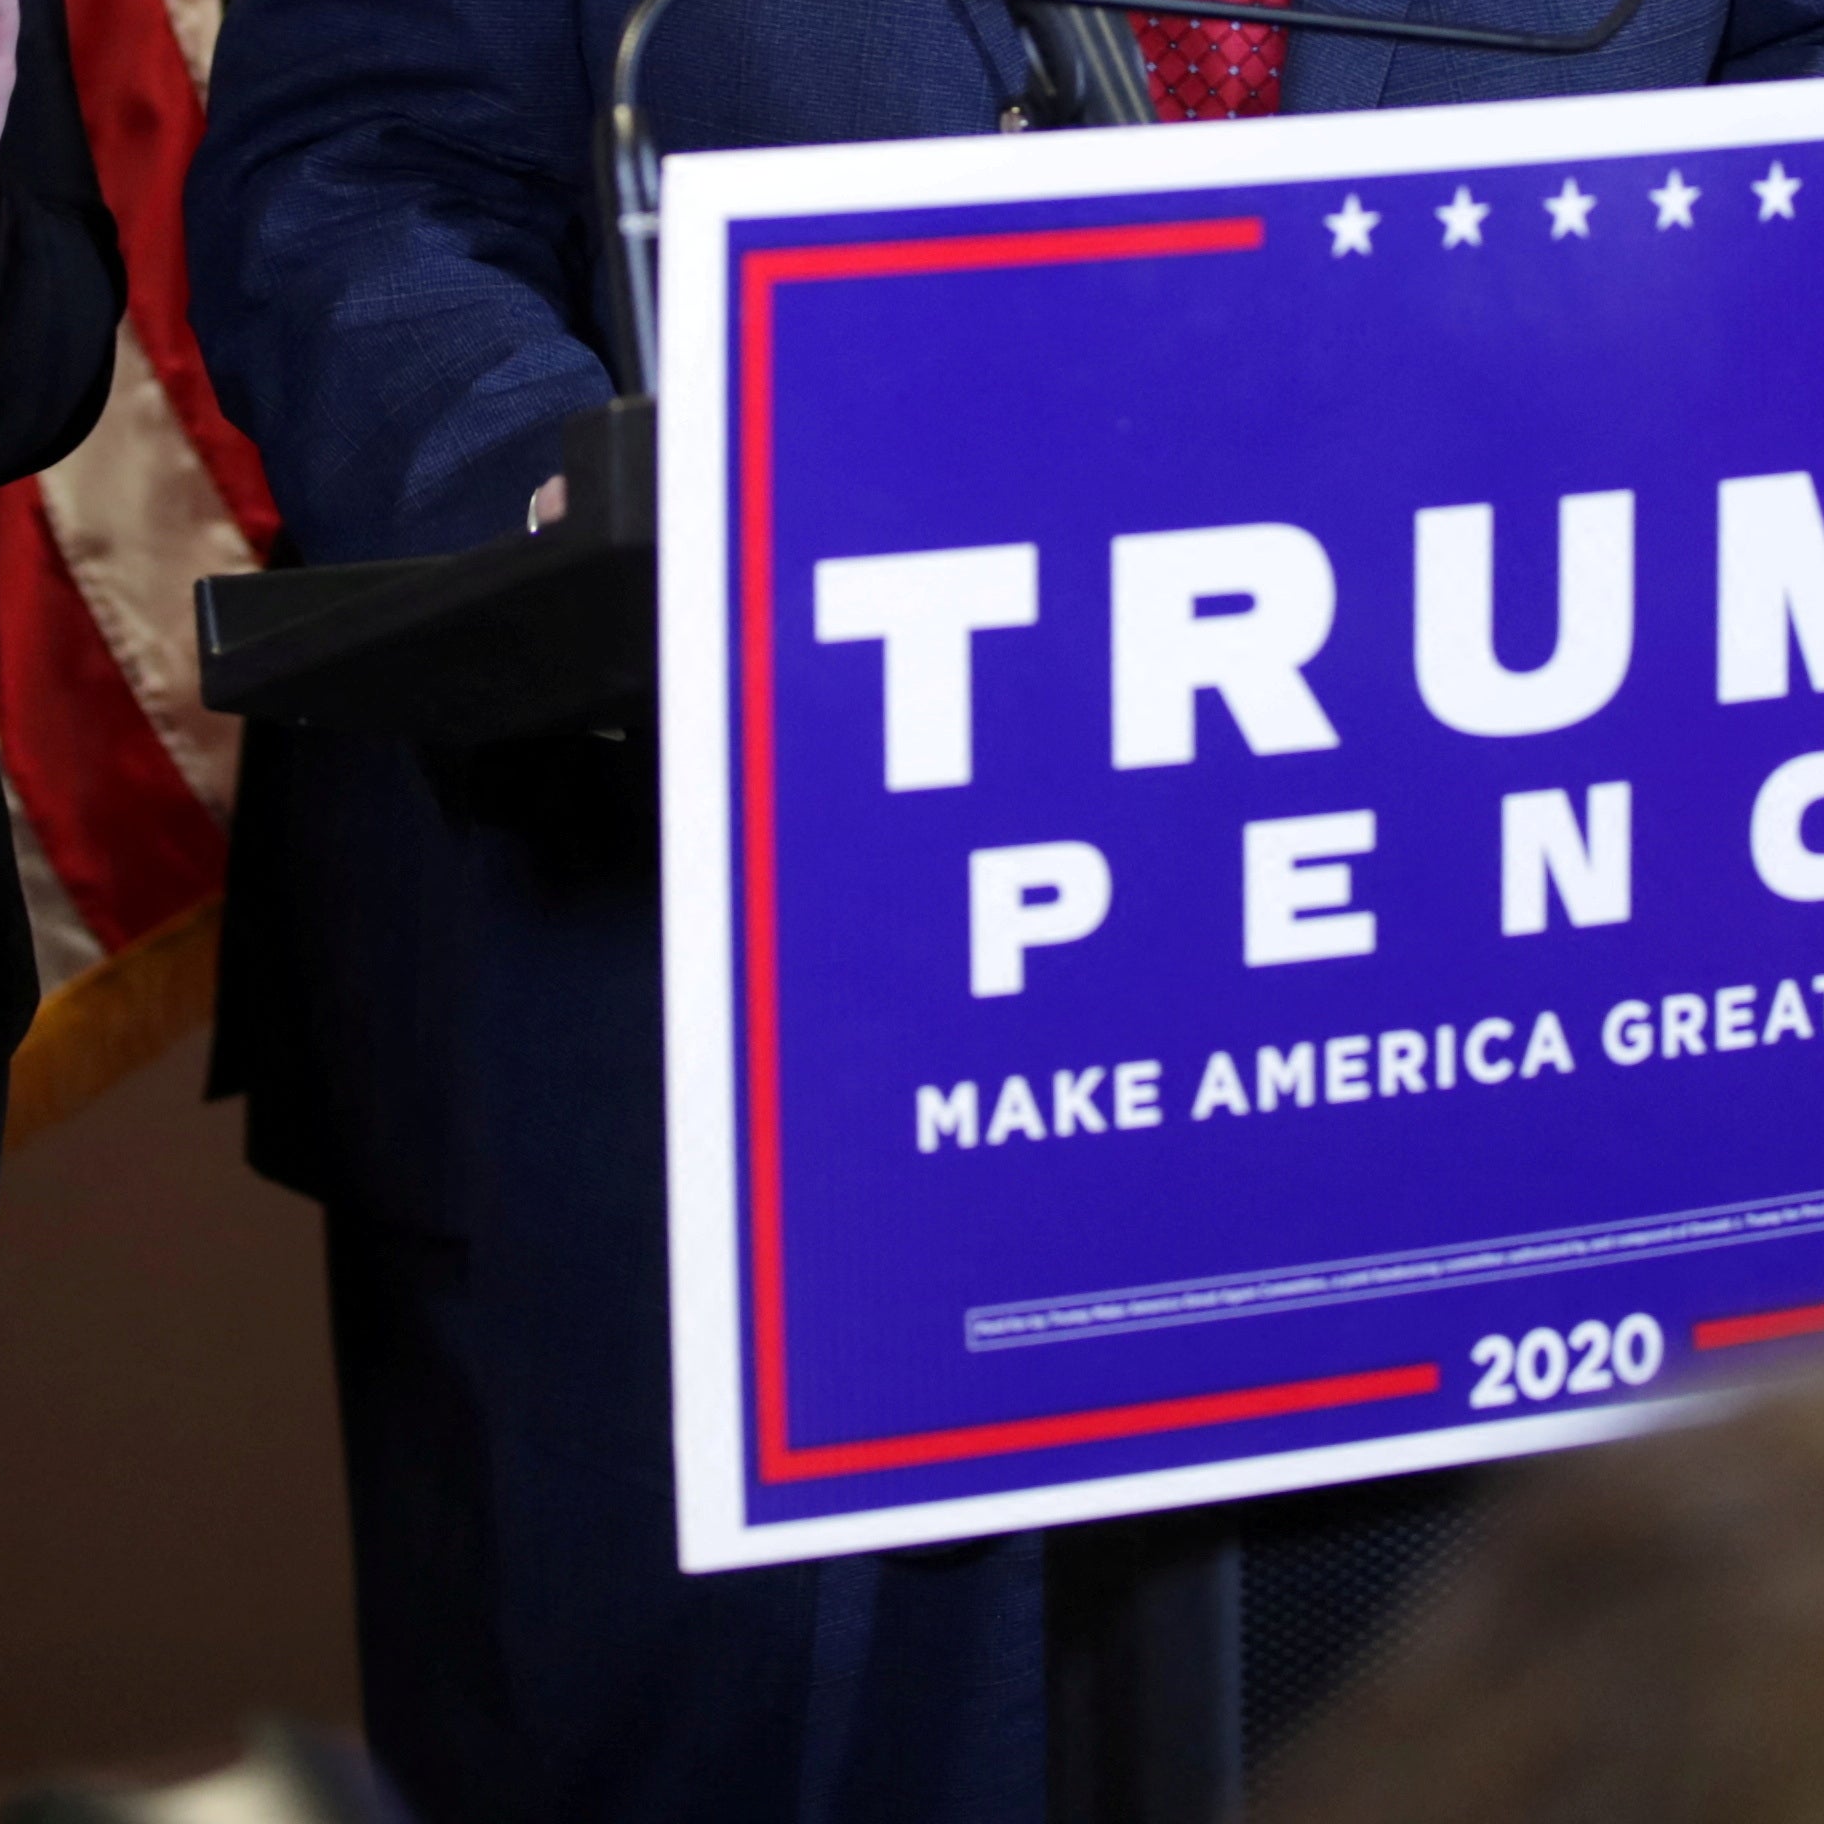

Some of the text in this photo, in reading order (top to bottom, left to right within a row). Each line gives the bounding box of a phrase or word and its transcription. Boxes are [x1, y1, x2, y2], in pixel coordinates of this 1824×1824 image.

[916, 1059, 1164, 1154] MAKE
[1191, 1010, 1575, 1121] AMERICA
[1468, 1312, 1665, 1410] 2020
